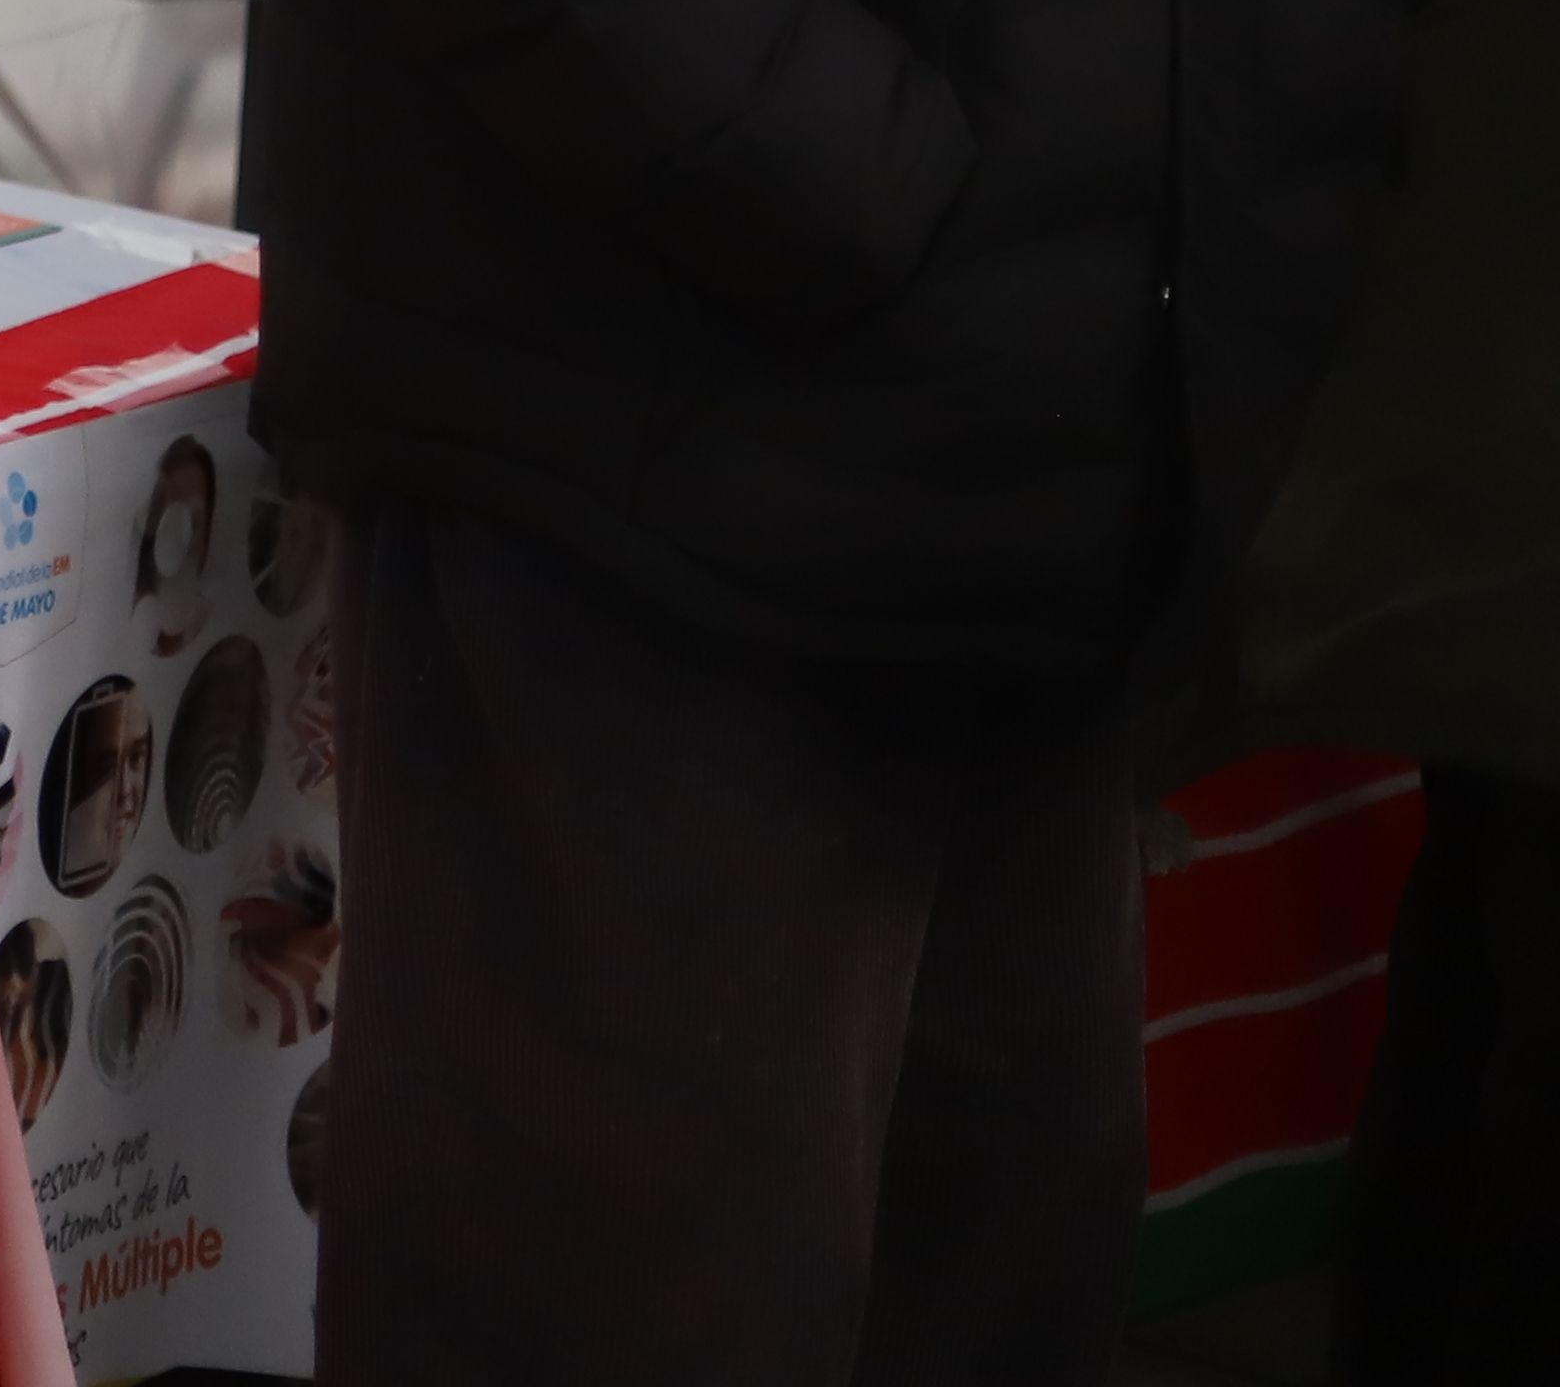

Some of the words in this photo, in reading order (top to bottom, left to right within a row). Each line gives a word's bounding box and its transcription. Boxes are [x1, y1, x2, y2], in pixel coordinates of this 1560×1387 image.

[10, 589, 56, 621] MAYO
[37, 1139, 105, 1204] esario
[112, 1131, 150, 1188] que
[165, 1161, 192, 1209] la
[79, 1215, 223, 1314] Múltiple
